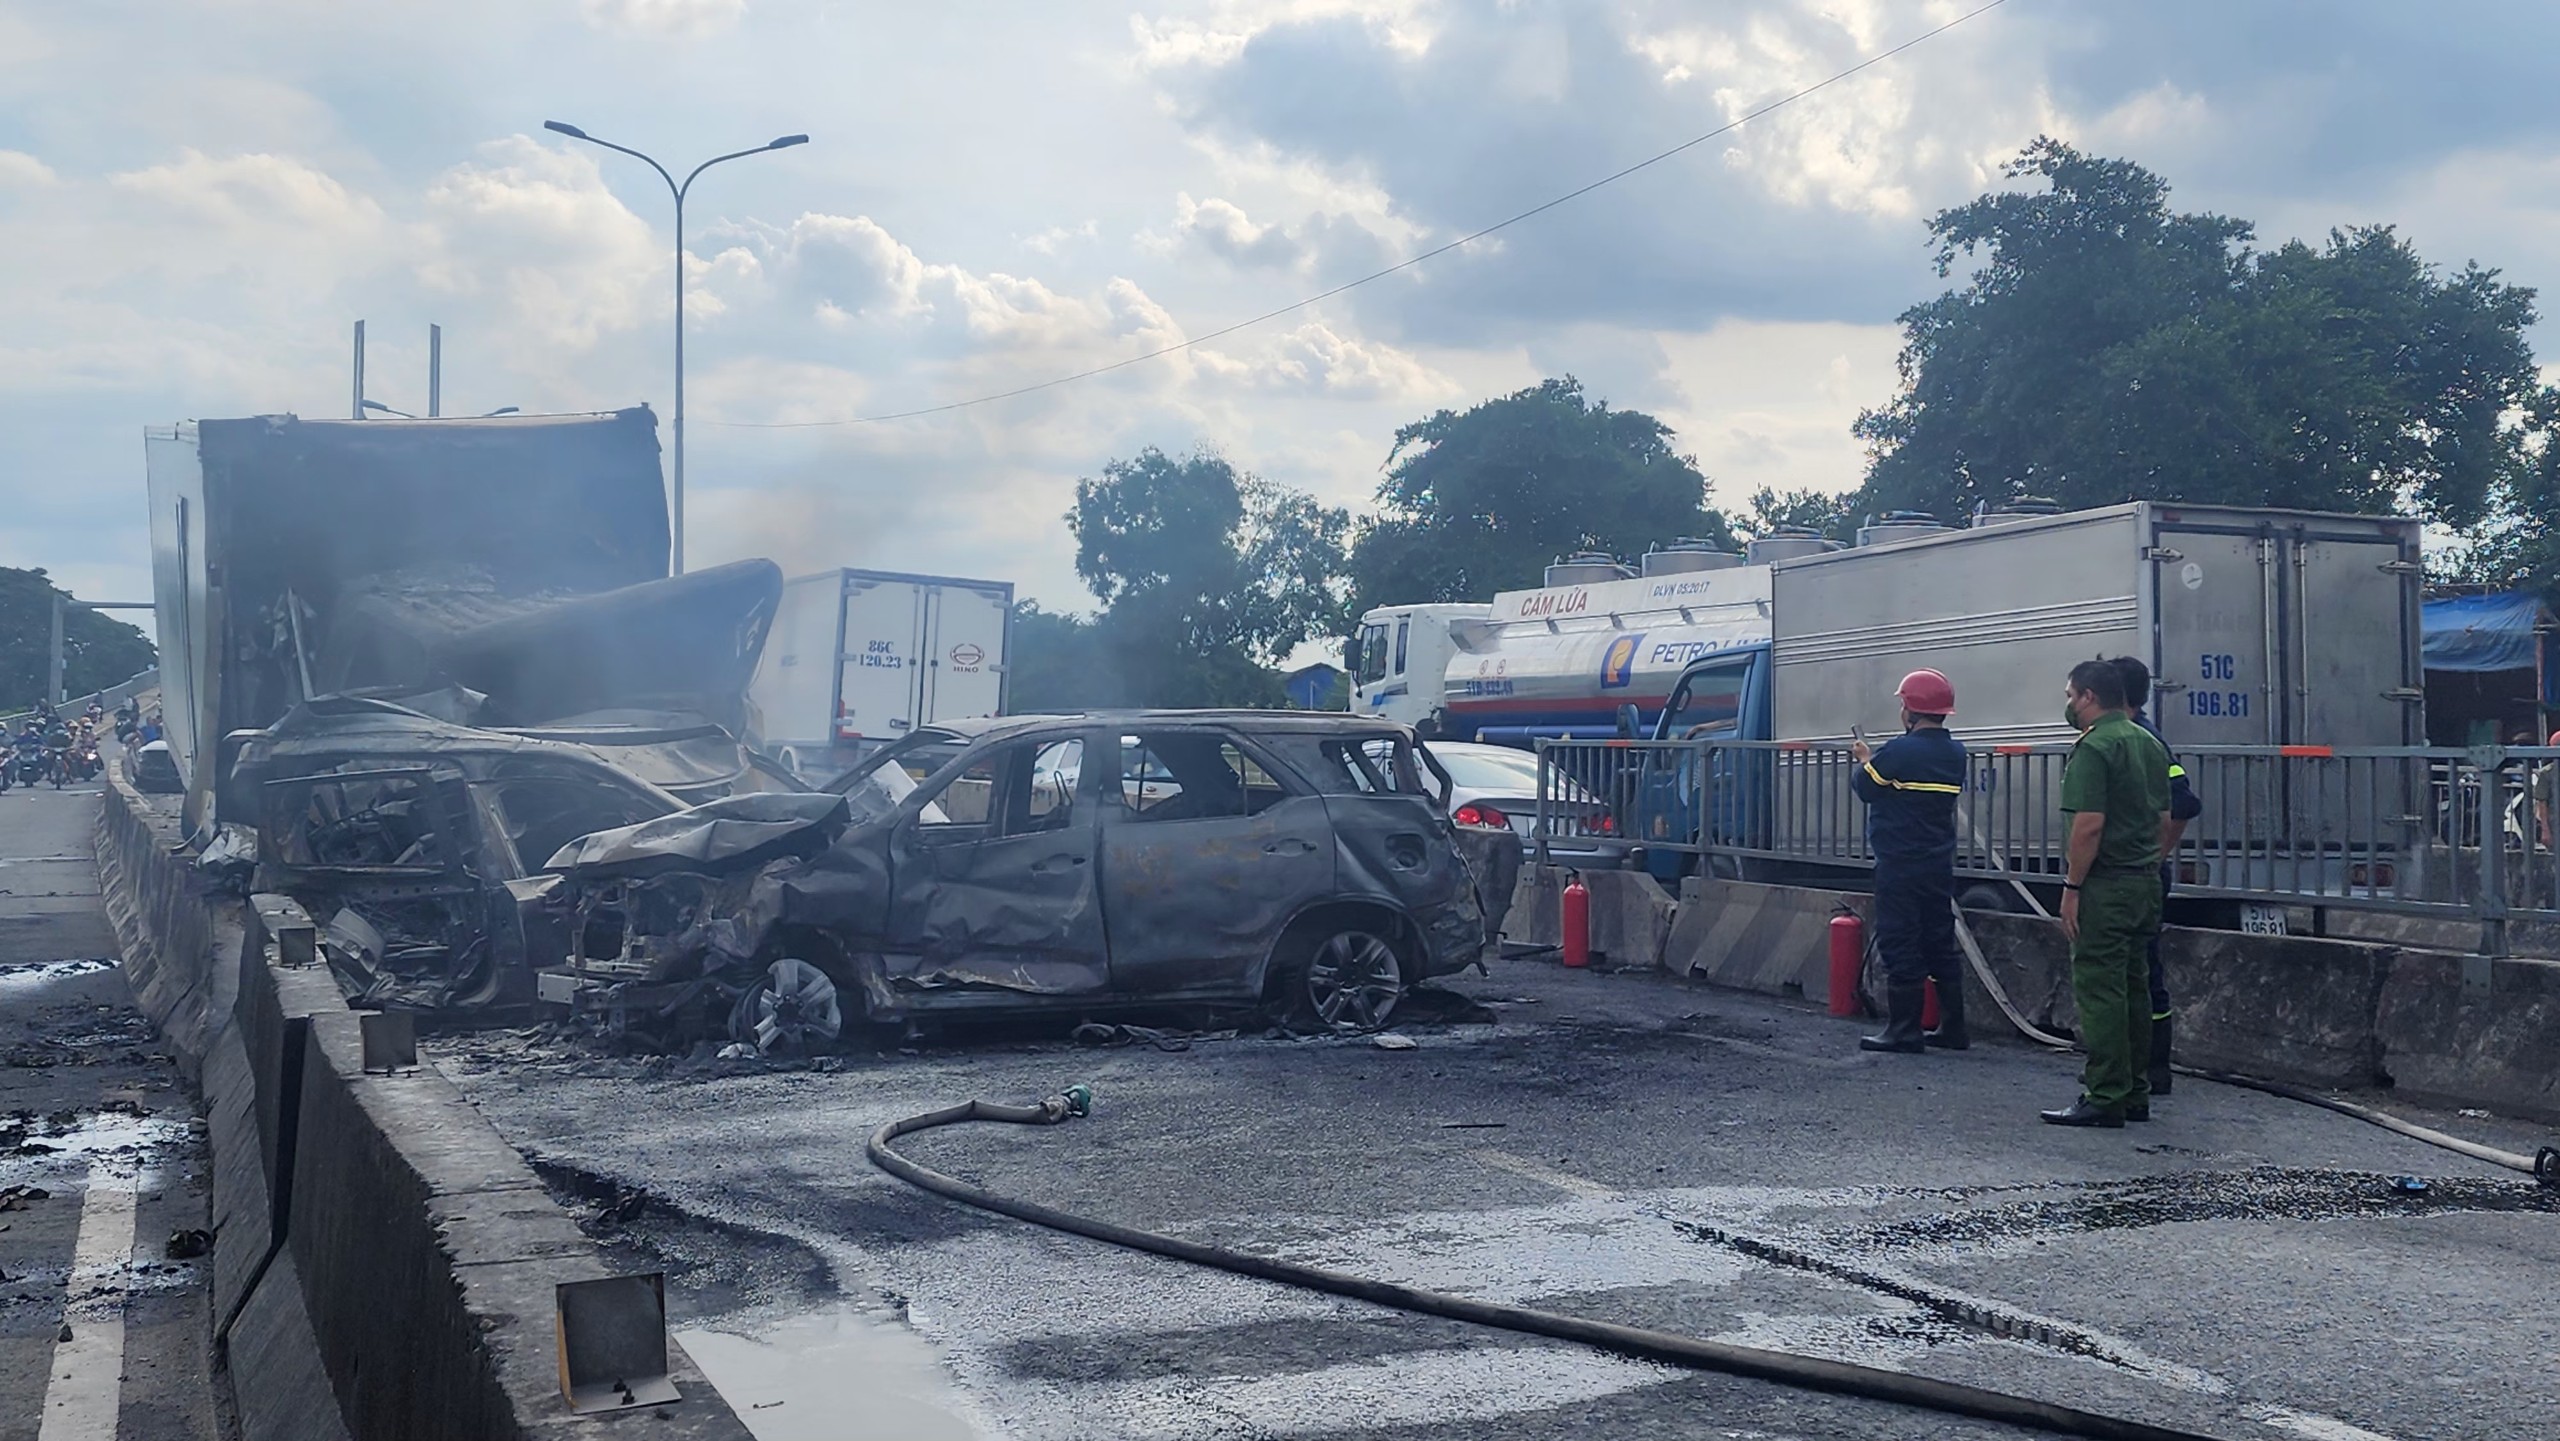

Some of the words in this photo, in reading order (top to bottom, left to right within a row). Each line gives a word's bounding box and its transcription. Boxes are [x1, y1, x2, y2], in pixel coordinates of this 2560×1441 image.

[868, 639, 895, 654] 86C
[859, 653, 902, 670] 120.23
[953, 665, 979, 674] HINO
[2201, 654, 2234, 680] 51C
[2187, 690, 2249, 718] 196.81
